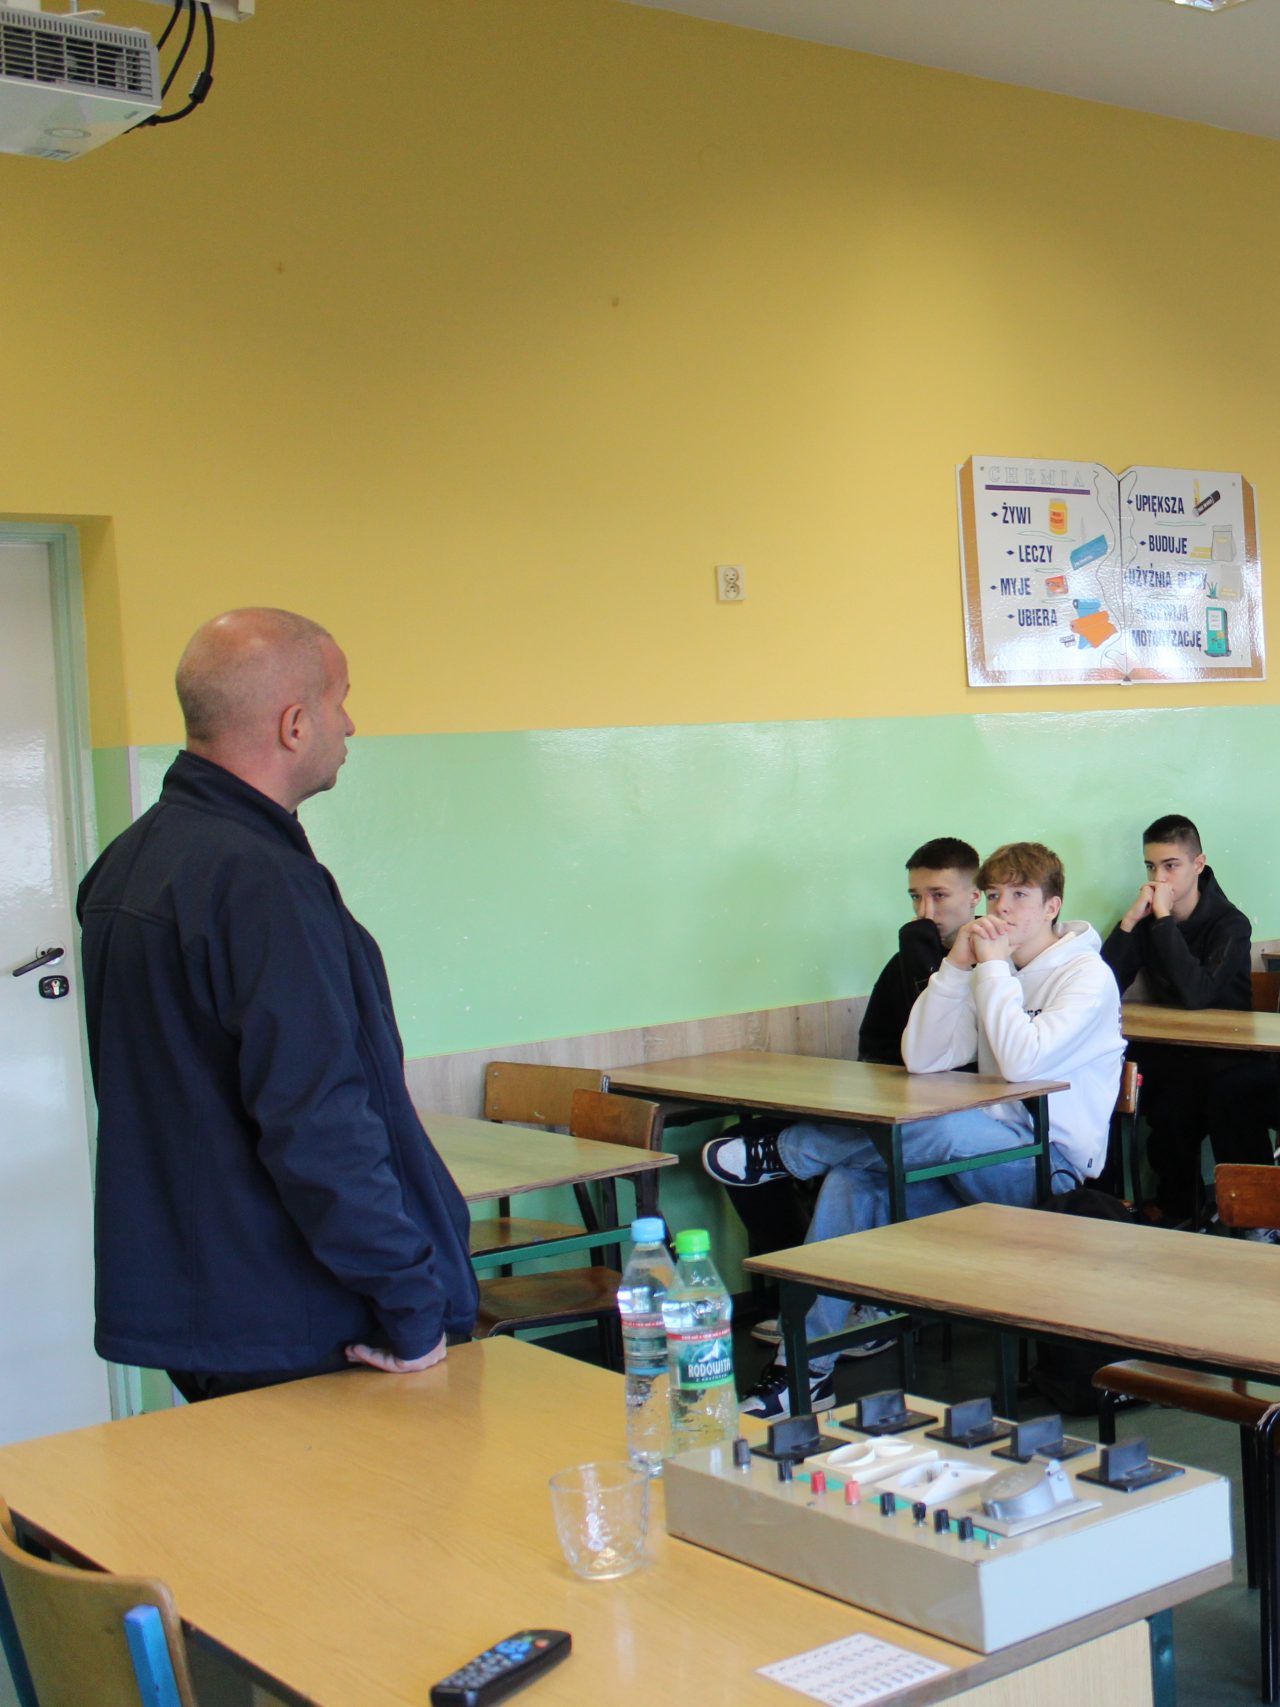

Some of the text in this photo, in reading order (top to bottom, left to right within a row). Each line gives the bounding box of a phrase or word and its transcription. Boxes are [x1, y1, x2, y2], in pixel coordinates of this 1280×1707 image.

[989, 466, 1084, 487] CHEMIA
[1002, 502, 1031, 524] ŻYWI
[1136, 494, 1185, 518] UPIĘKSZA
[1018, 545, 1053, 563] LECZY
[1149, 535, 1187, 555] BUDUJE
[1000, 578, 1031, 595] MYJE
[1018, 609, 1057, 627] UBIERA
[1132, 630, 1202, 651] MOTZACJĘ
